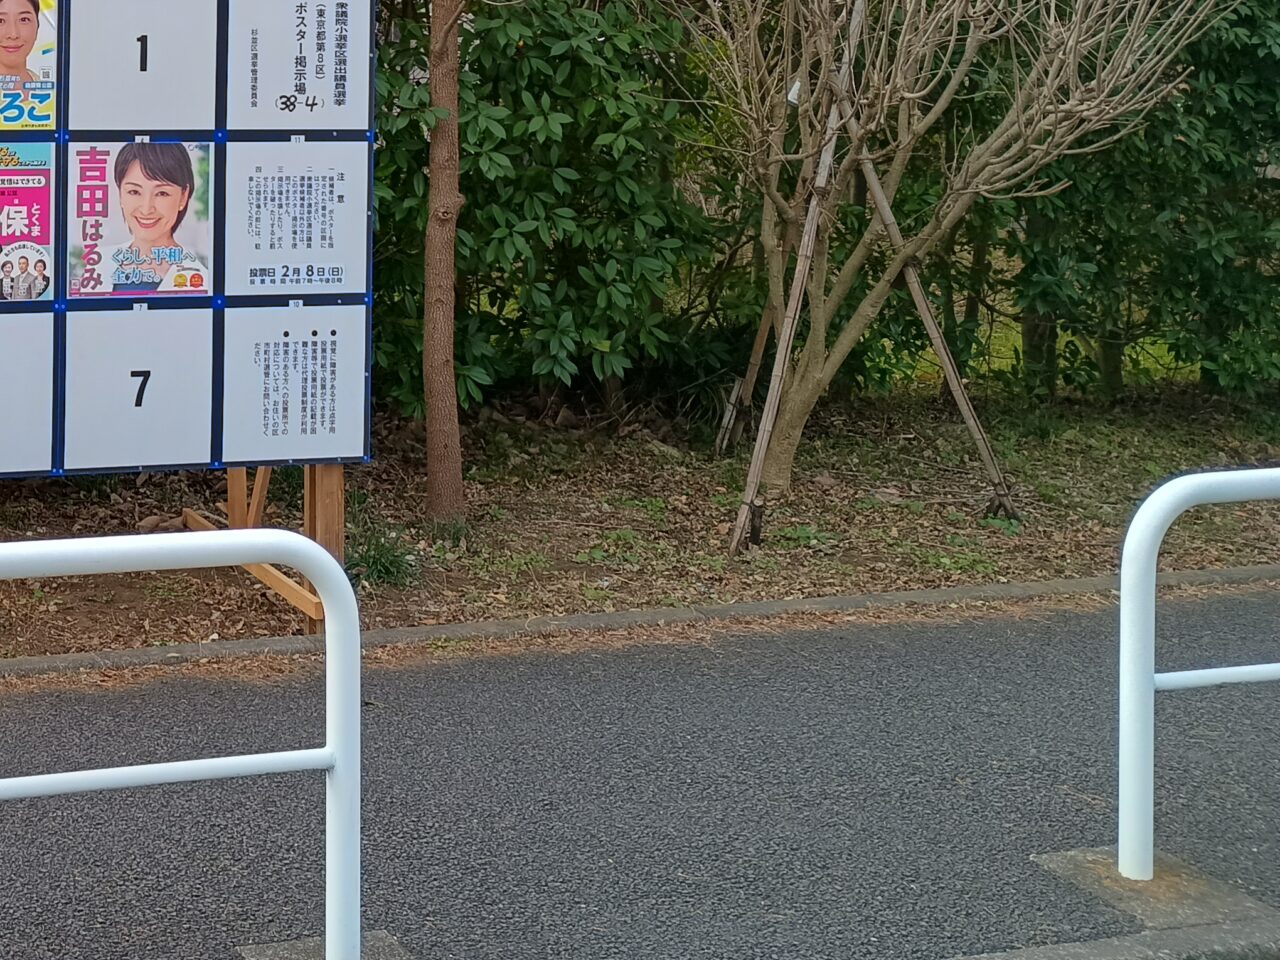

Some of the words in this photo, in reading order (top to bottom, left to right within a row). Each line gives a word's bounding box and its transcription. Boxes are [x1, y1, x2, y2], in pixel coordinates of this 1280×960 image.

[136, 35, 148, 72] 1
[294, 2, 308, 95] ポスター掲示場
[333, 2, 348, 107] 衆議院小選挙区選出議員選挙
[31, 203, 41, 237] とくま
[76, 146, 110, 290] 吉田はるみ
[249, 267, 276, 278] 投票日
[130, 370, 151, 407] 7
